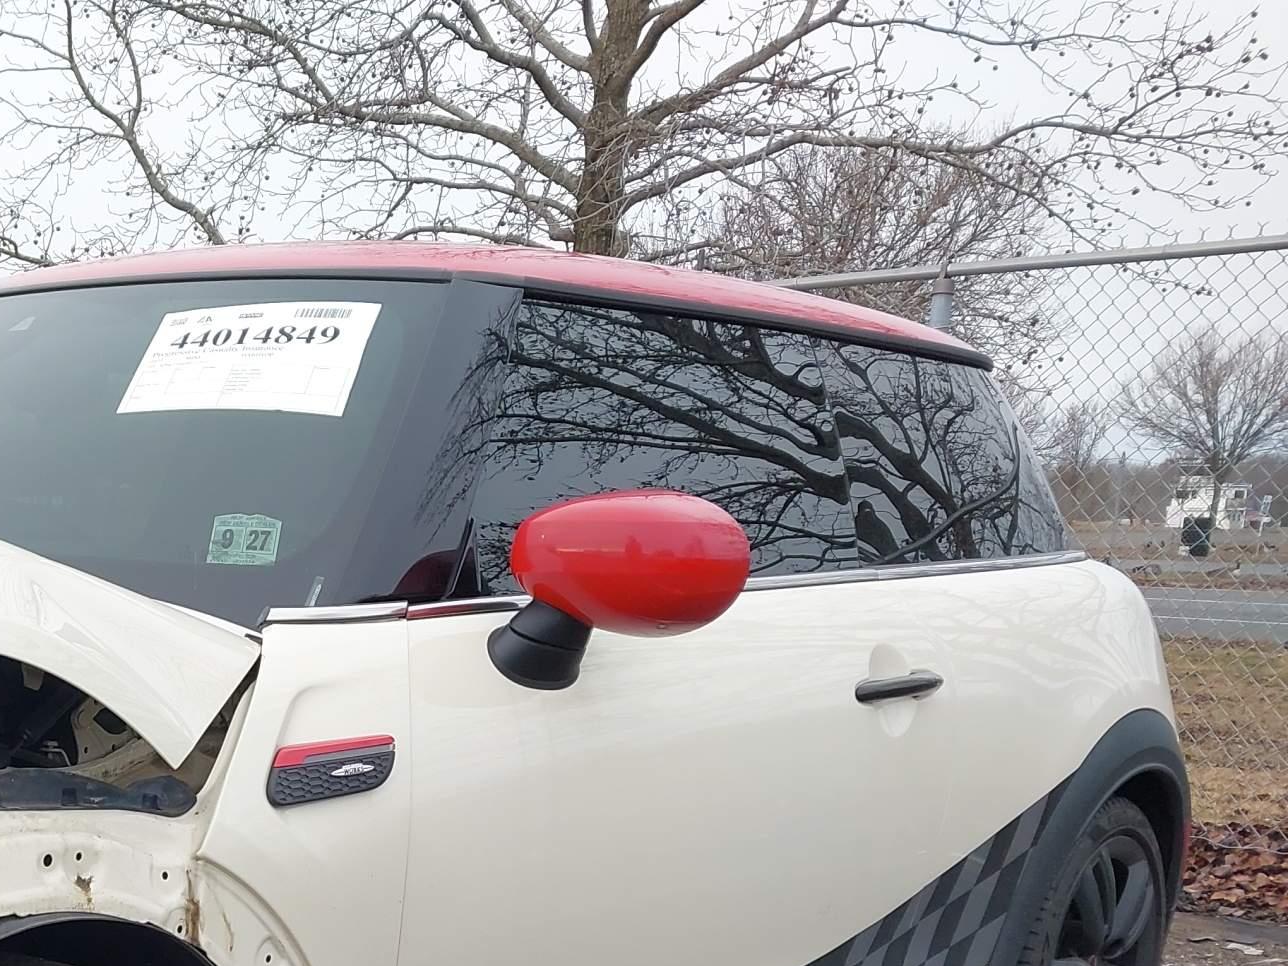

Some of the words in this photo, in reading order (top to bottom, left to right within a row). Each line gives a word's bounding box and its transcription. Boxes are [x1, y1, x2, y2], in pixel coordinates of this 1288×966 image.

[170, 324, 340, 349] 44014849
[220, 528, 234, 549] 9
[245, 529, 271, 551] 27
